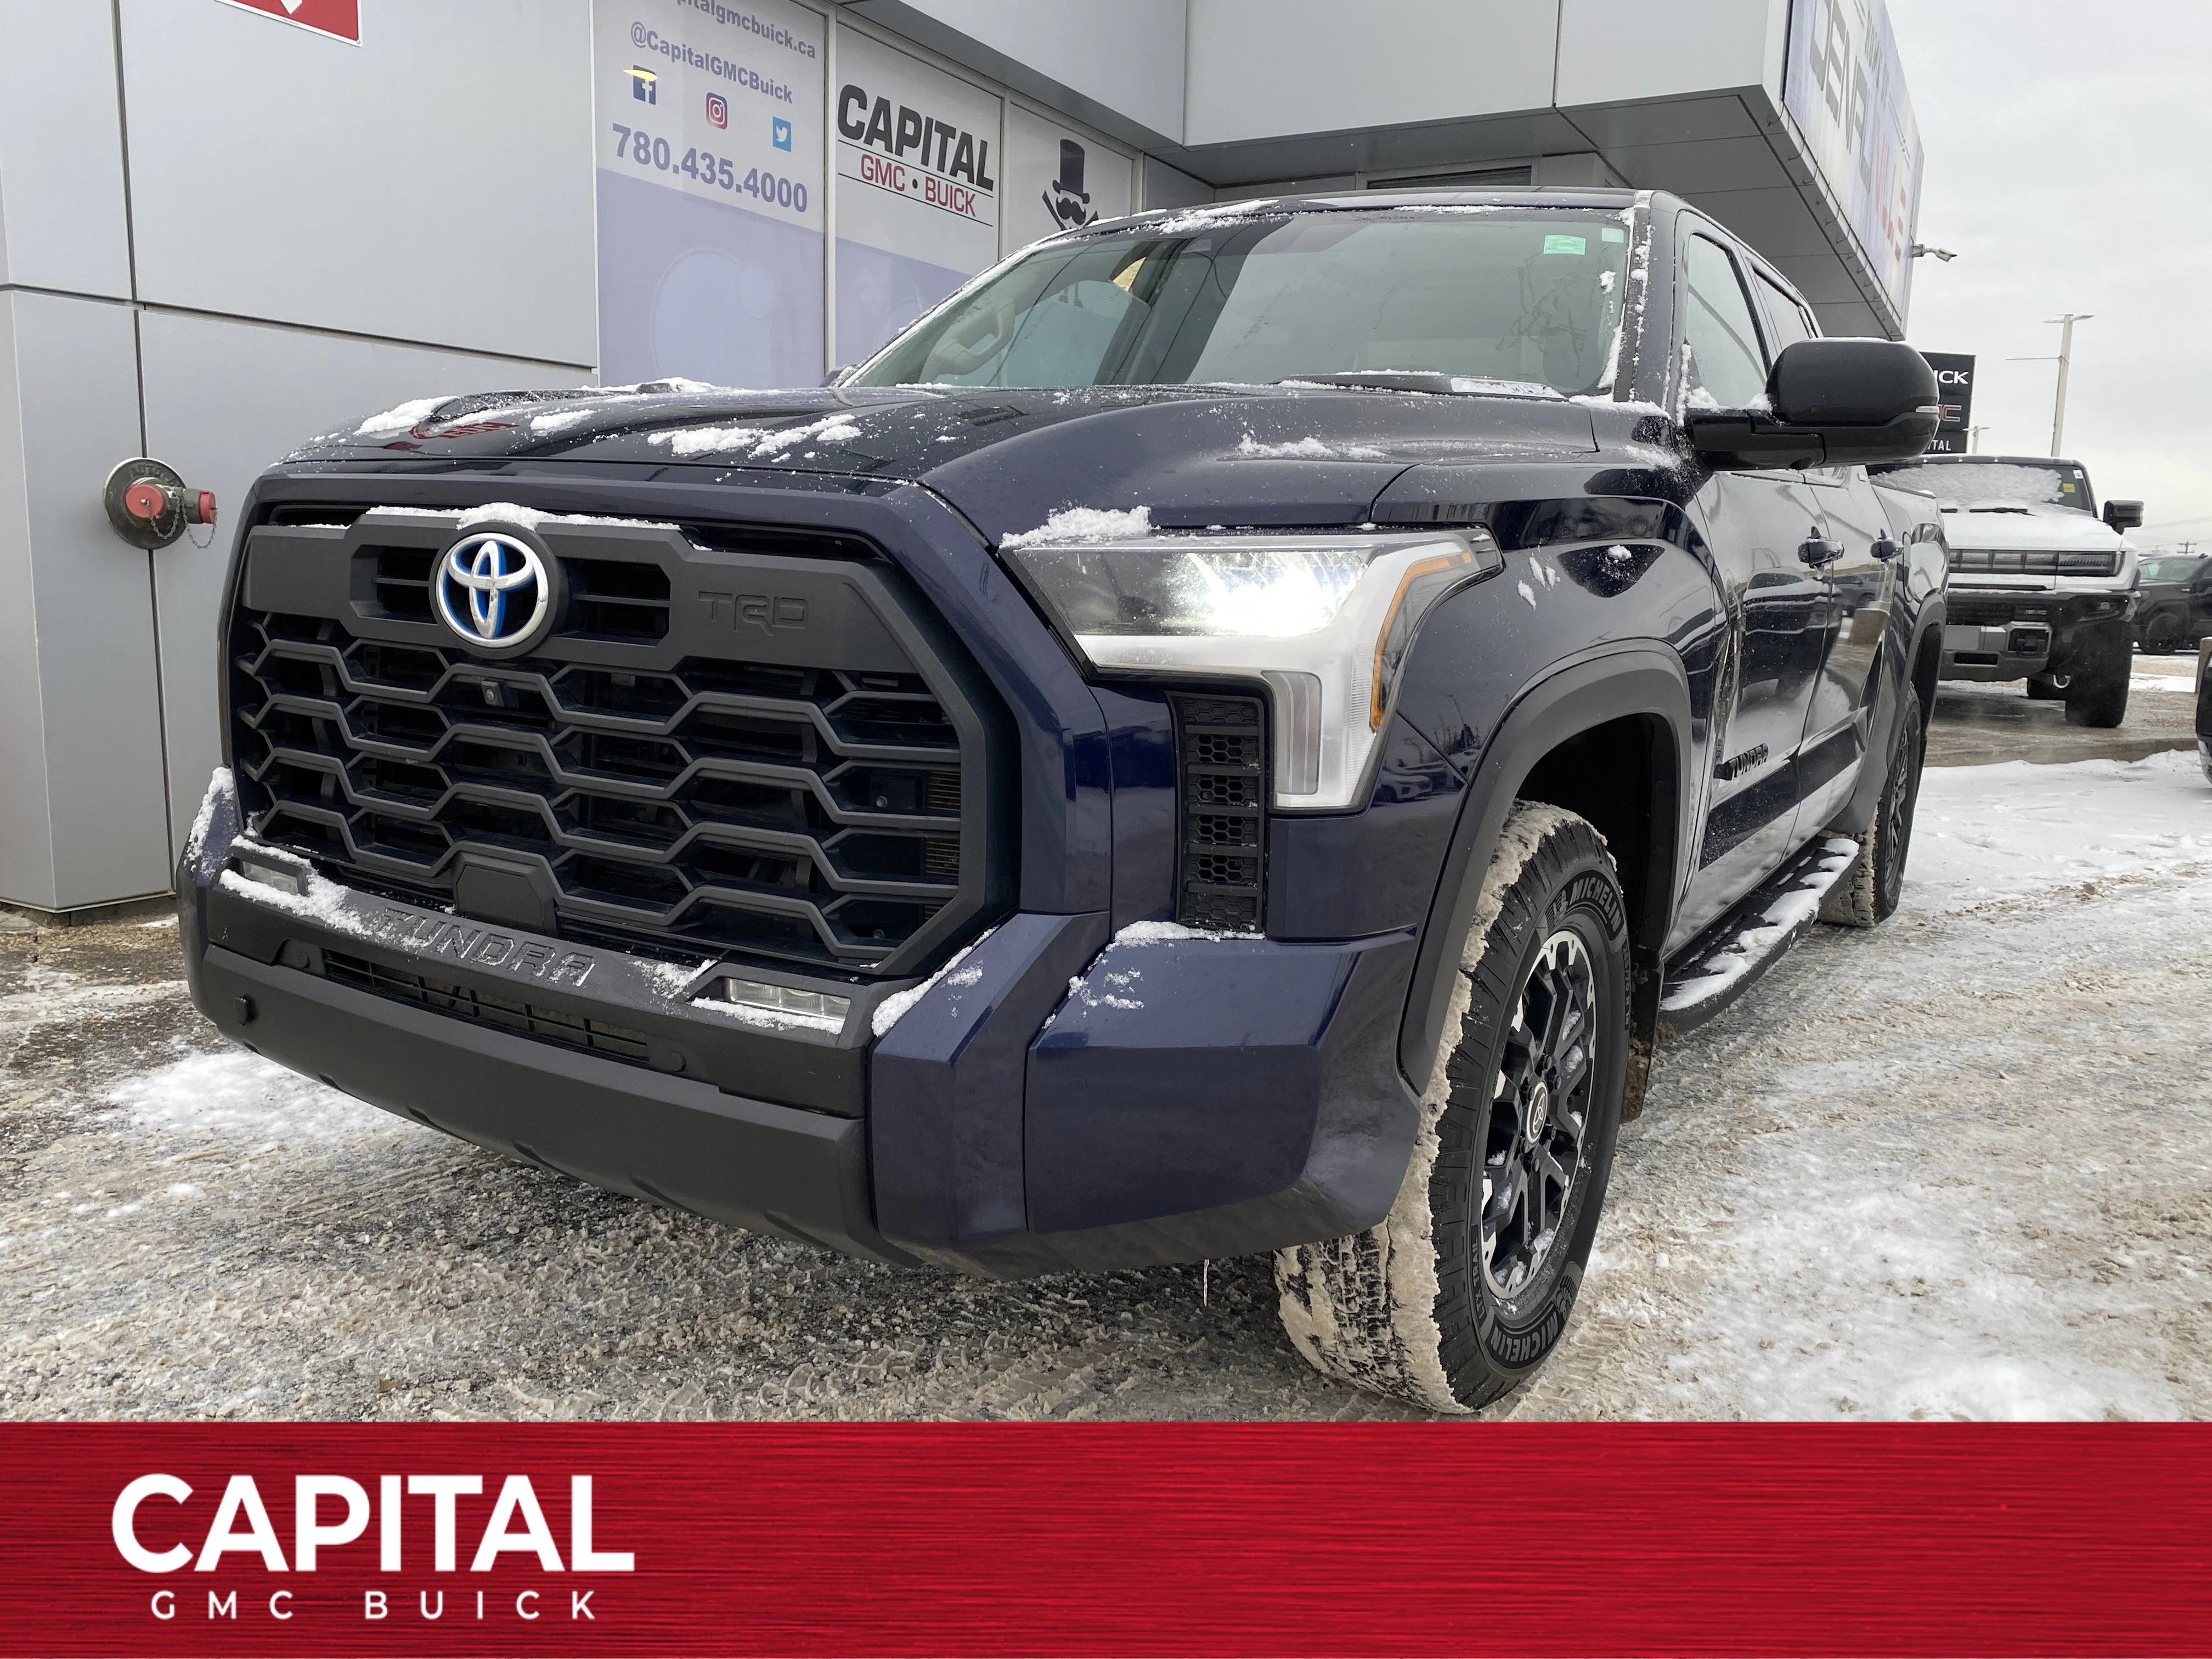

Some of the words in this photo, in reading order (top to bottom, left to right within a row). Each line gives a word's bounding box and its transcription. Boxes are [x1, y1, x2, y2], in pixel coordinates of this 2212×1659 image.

[677, 0, 815, 59] talgmcbuick.ca
[630, 21, 792, 104] @CapitalGMCBuick
[838, 84, 994, 191] CAPITAL
[612, 123, 808, 212] 780.435.4000
[860, 154, 905, 191] GMC
[925, 176, 976, 217] BUICK
[1934, 370, 1969, 384] ICK
[698, 591, 809, 636] TRD
[1569, 877, 1621, 933] MICHELIN
[1475, 1289, 1485, 1319] LTX
[1491, 1311, 1559, 1362] MICHELIN
